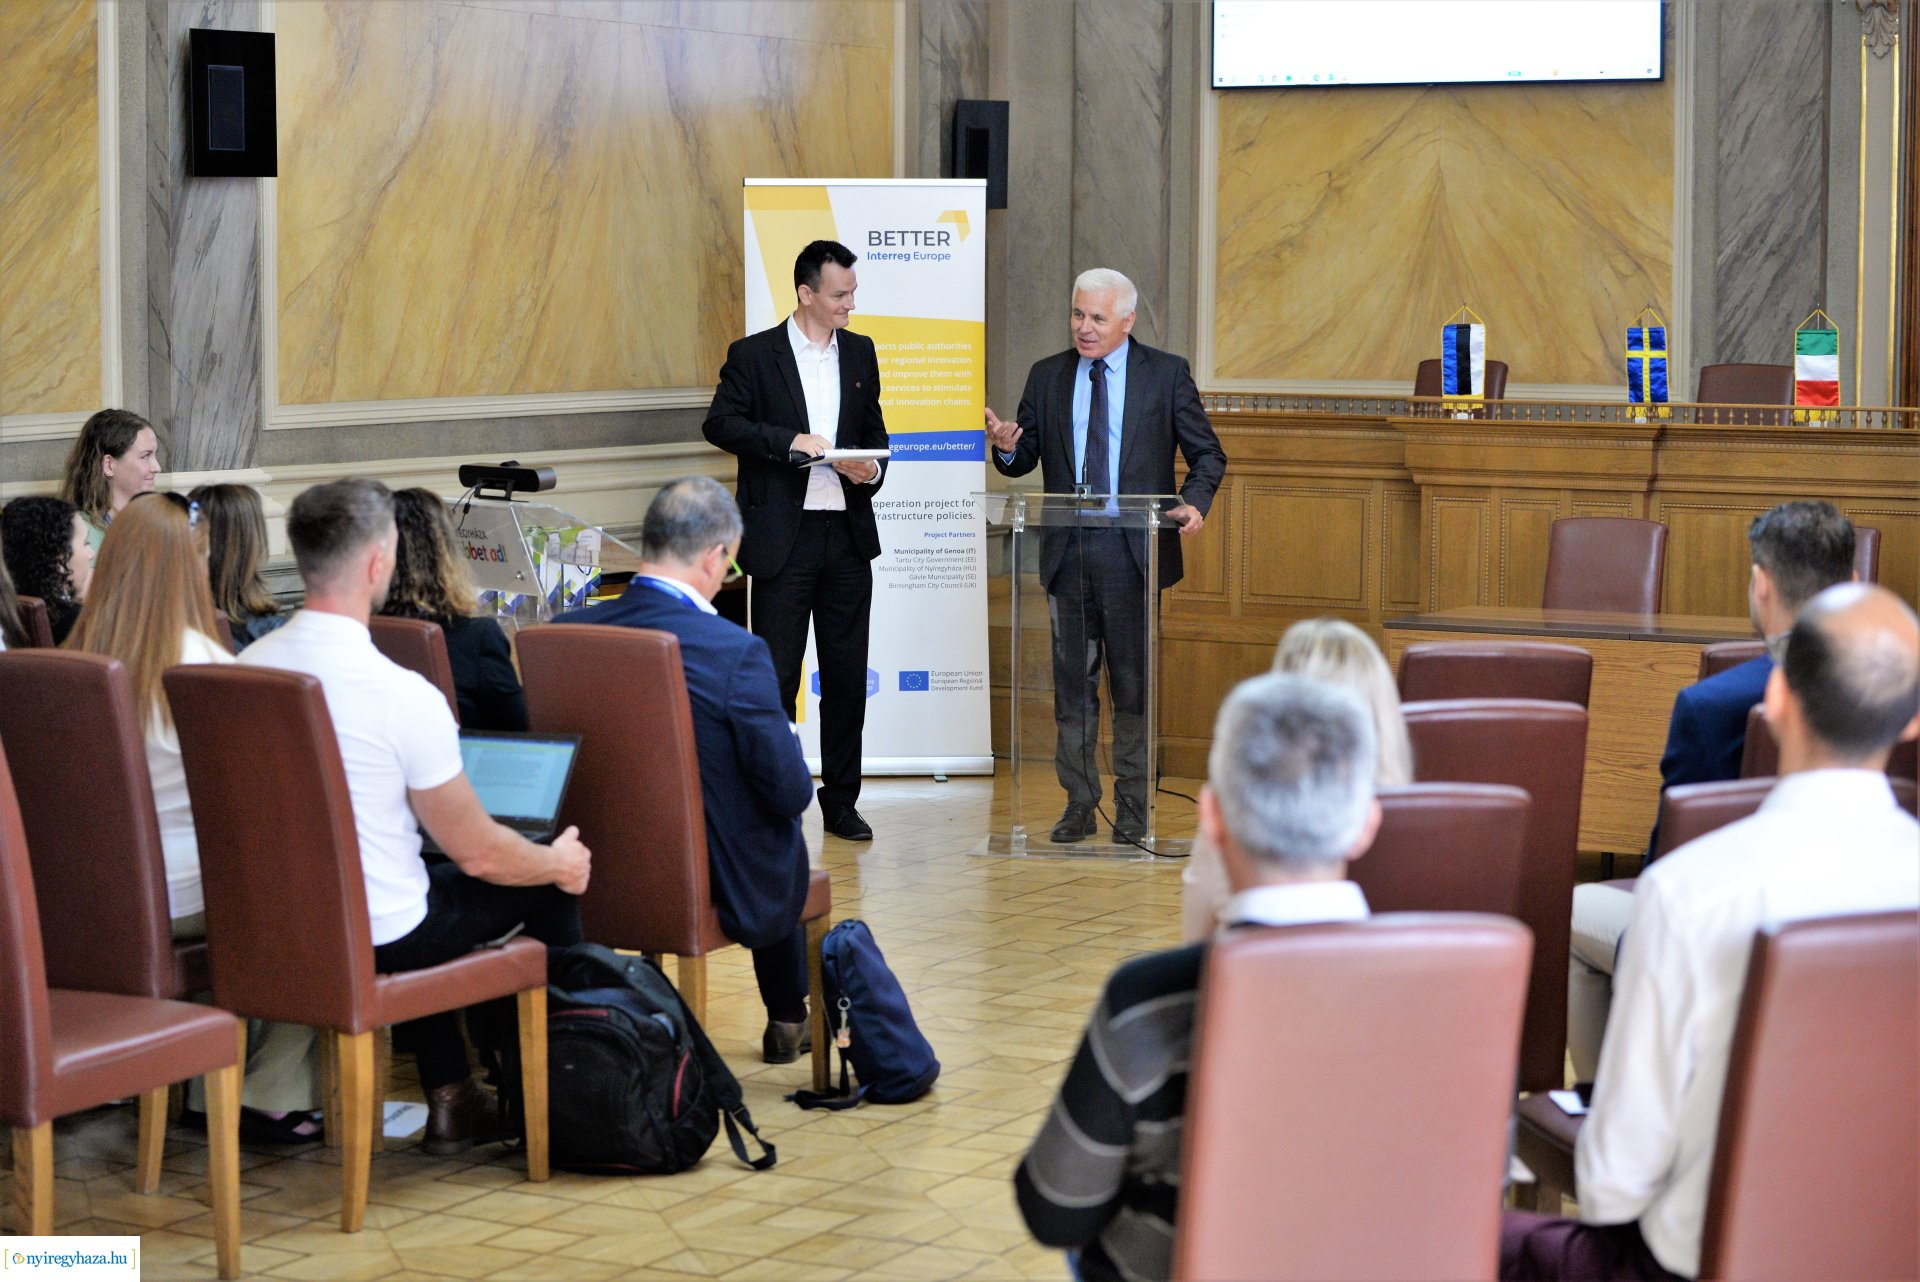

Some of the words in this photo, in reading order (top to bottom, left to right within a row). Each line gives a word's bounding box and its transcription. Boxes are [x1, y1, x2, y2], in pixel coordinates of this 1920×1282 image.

[867, 230, 951, 247] BETTER
[867, 251, 911, 262] Interreg
[913, 251, 951, 262] Europe
[899, 342, 924, 352] public
[927, 342, 972, 350] authorities
[891, 356, 925, 365] regional
[893, 370, 928, 379] improve
[887, 384, 920, 392] services
[933, 384, 972, 392] stimulate
[896, 398, 941, 406] innovation
[889, 442, 976, 452] egeurope.eu/better/
[872, 500, 921, 510] operation
[924, 499, 959, 510] project
[962, 499, 975, 508] for
[936, 511, 975, 522] policies.
[879, 565, 916, 573] Municipality
[931, 670, 962, 678] European
